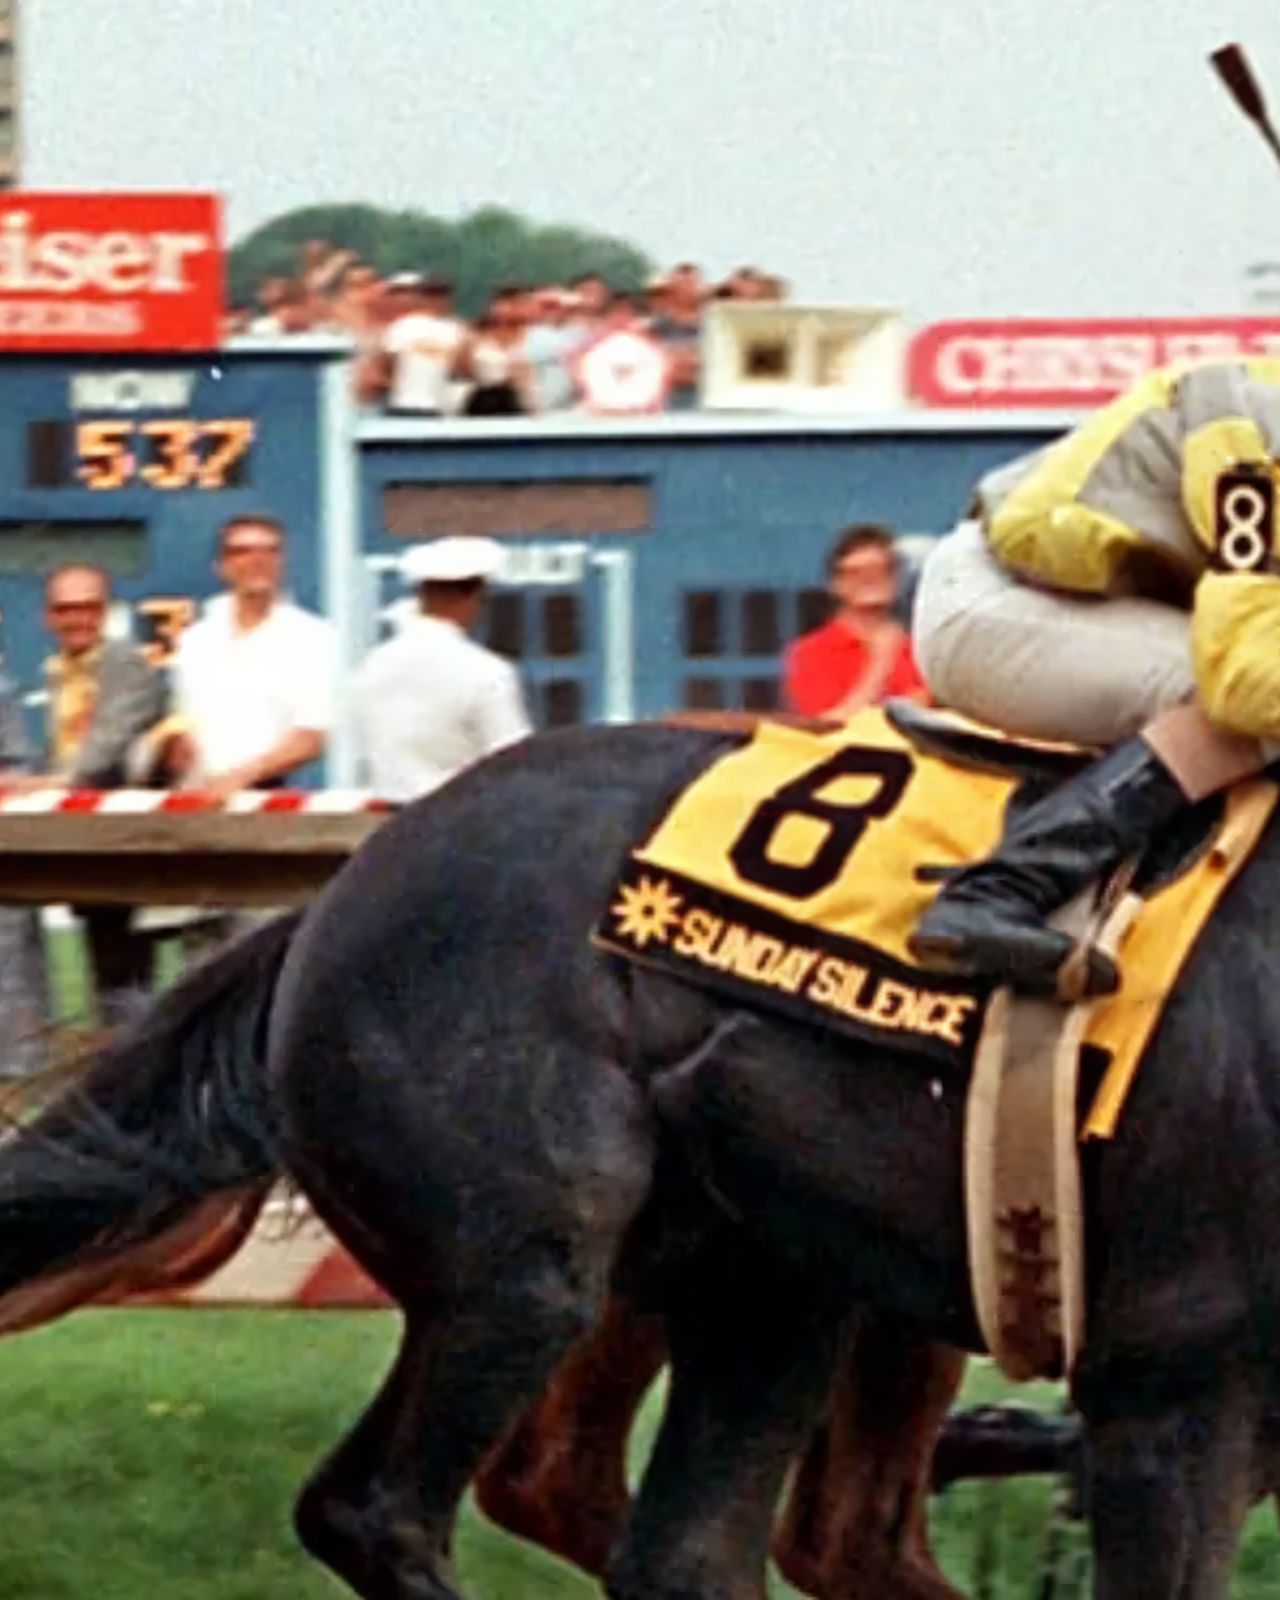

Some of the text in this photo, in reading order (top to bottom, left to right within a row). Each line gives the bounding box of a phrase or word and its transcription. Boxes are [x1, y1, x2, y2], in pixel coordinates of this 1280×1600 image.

[75, 419, 253, 491] 537
[1222, 484, 1265, 570] 8
[727, 744, 914, 898] 8
[673, 909, 977, 1046] SUNDAY SILENCE
